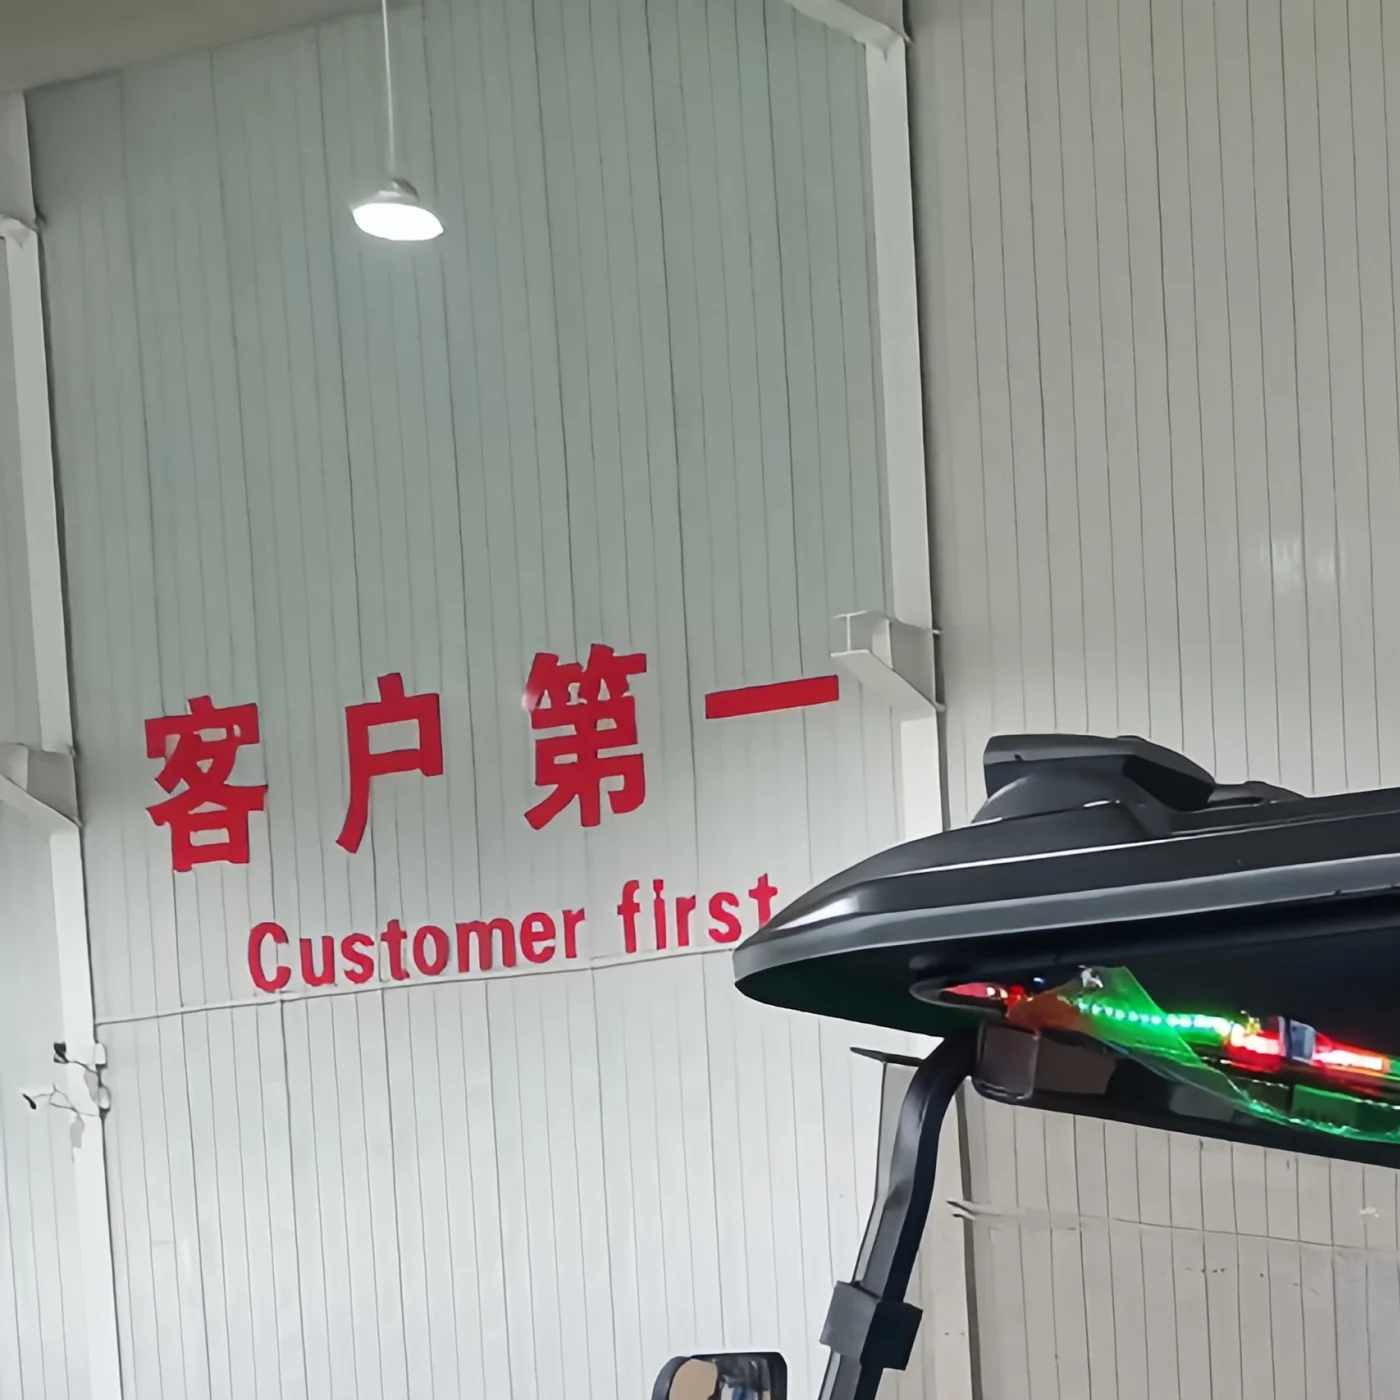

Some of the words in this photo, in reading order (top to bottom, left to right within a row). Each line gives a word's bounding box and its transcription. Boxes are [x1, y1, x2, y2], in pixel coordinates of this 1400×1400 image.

[145, 643, 840, 872] 客户第一
[247, 909, 586, 993] Customer
[617, 873, 779, 953] first
